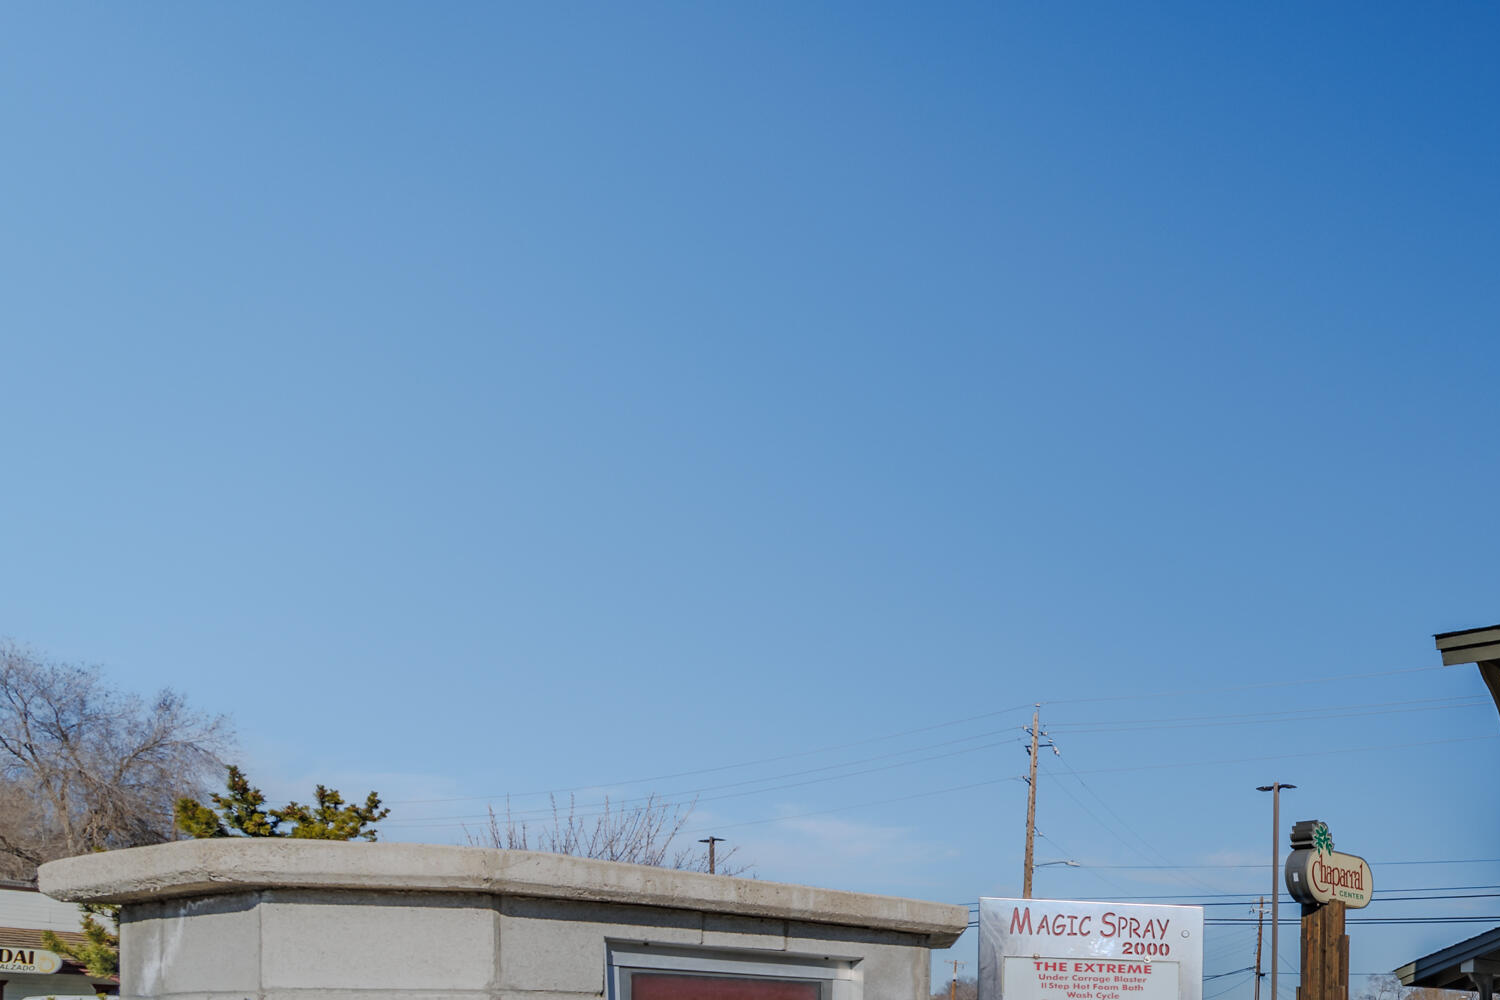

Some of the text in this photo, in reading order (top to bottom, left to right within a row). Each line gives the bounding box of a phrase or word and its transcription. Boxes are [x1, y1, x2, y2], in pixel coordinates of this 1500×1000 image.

[1312, 854, 1364, 896] Chaparral
[1340, 891, 1364, 900] CENTER
[1010, 907, 1170, 940] MAGIC SPRAY
[1122, 942, 1170, 956] 2000
[1033, 962, 1152, 974] THE EXTREME
[1048, 983, 1070, 991] Step
[1093, 983, 1119, 991] Foam
[1096, 992, 1120, 1000] Cycle
